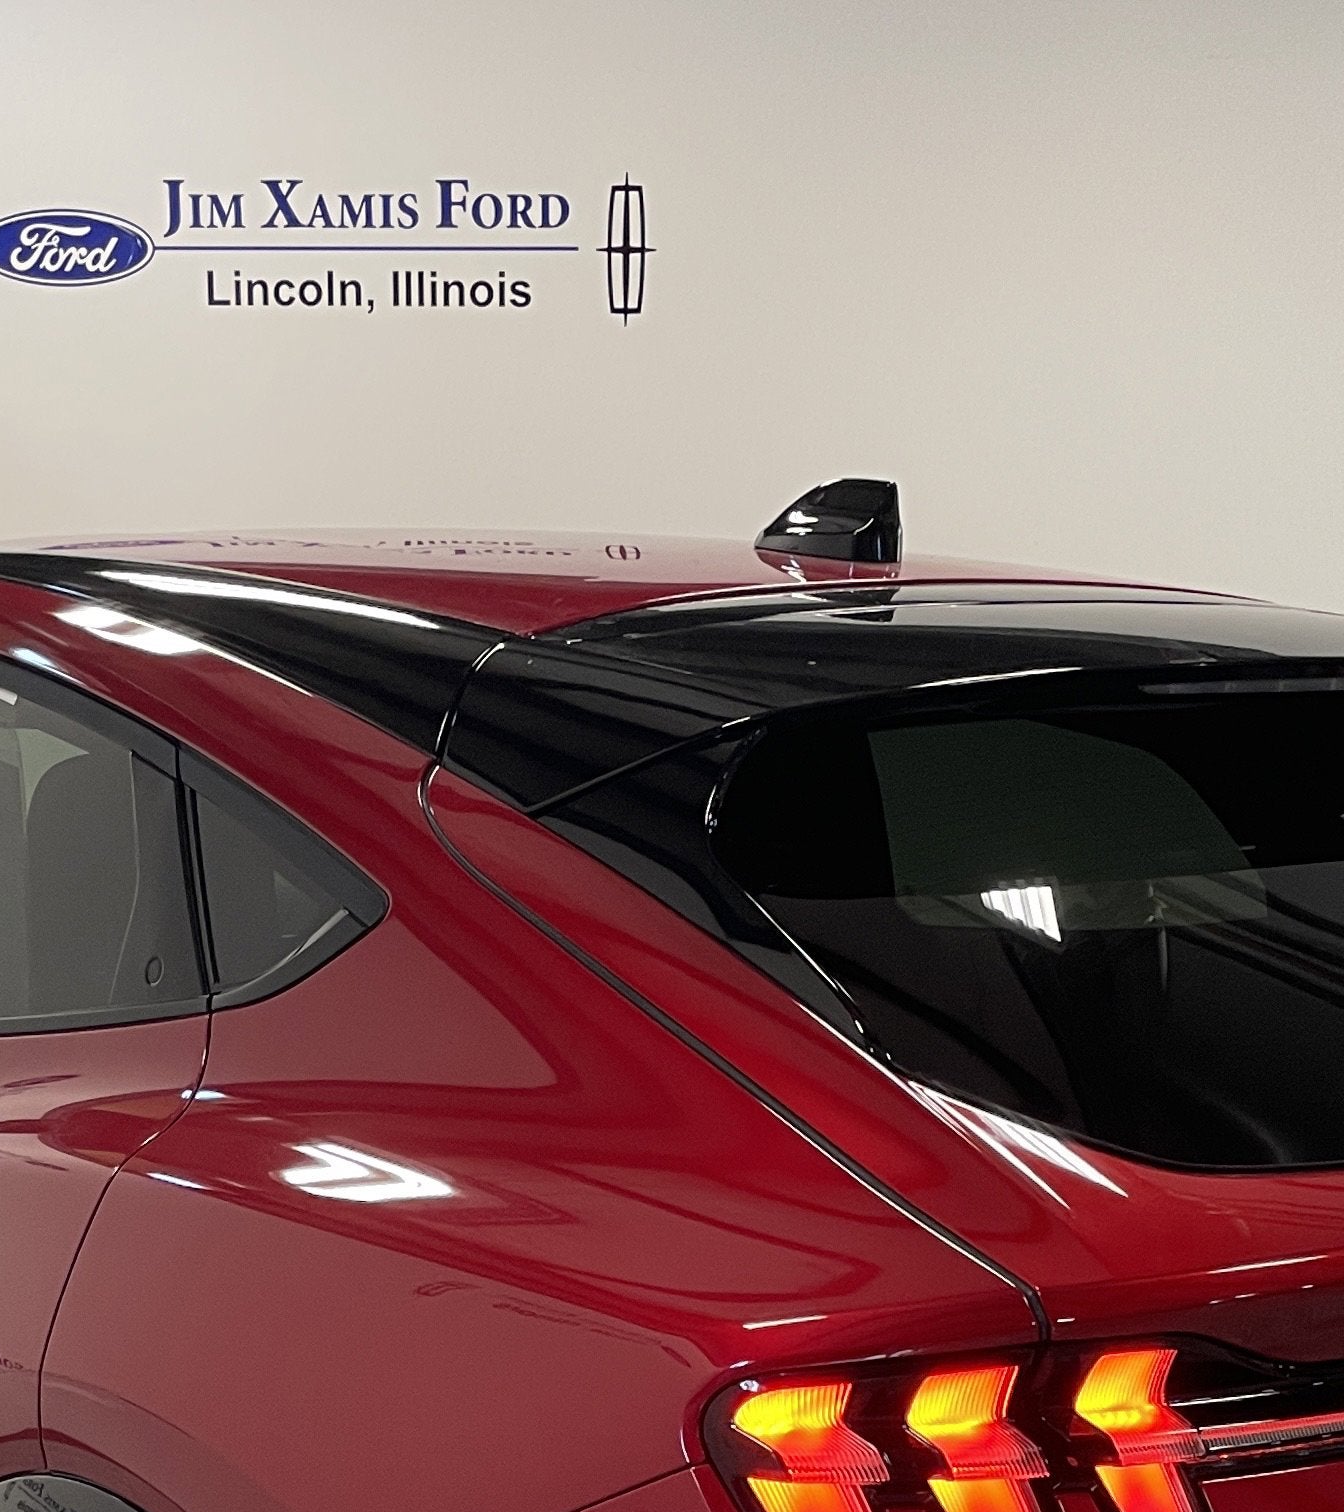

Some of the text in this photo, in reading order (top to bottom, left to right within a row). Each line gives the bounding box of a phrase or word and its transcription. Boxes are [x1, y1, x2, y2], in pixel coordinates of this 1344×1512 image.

[162, 179, 571, 238] JIM XAMIS FORD
[10, 223, 117, 275] Ford
[206, 270, 532, 314] Lincoln, Illinois
